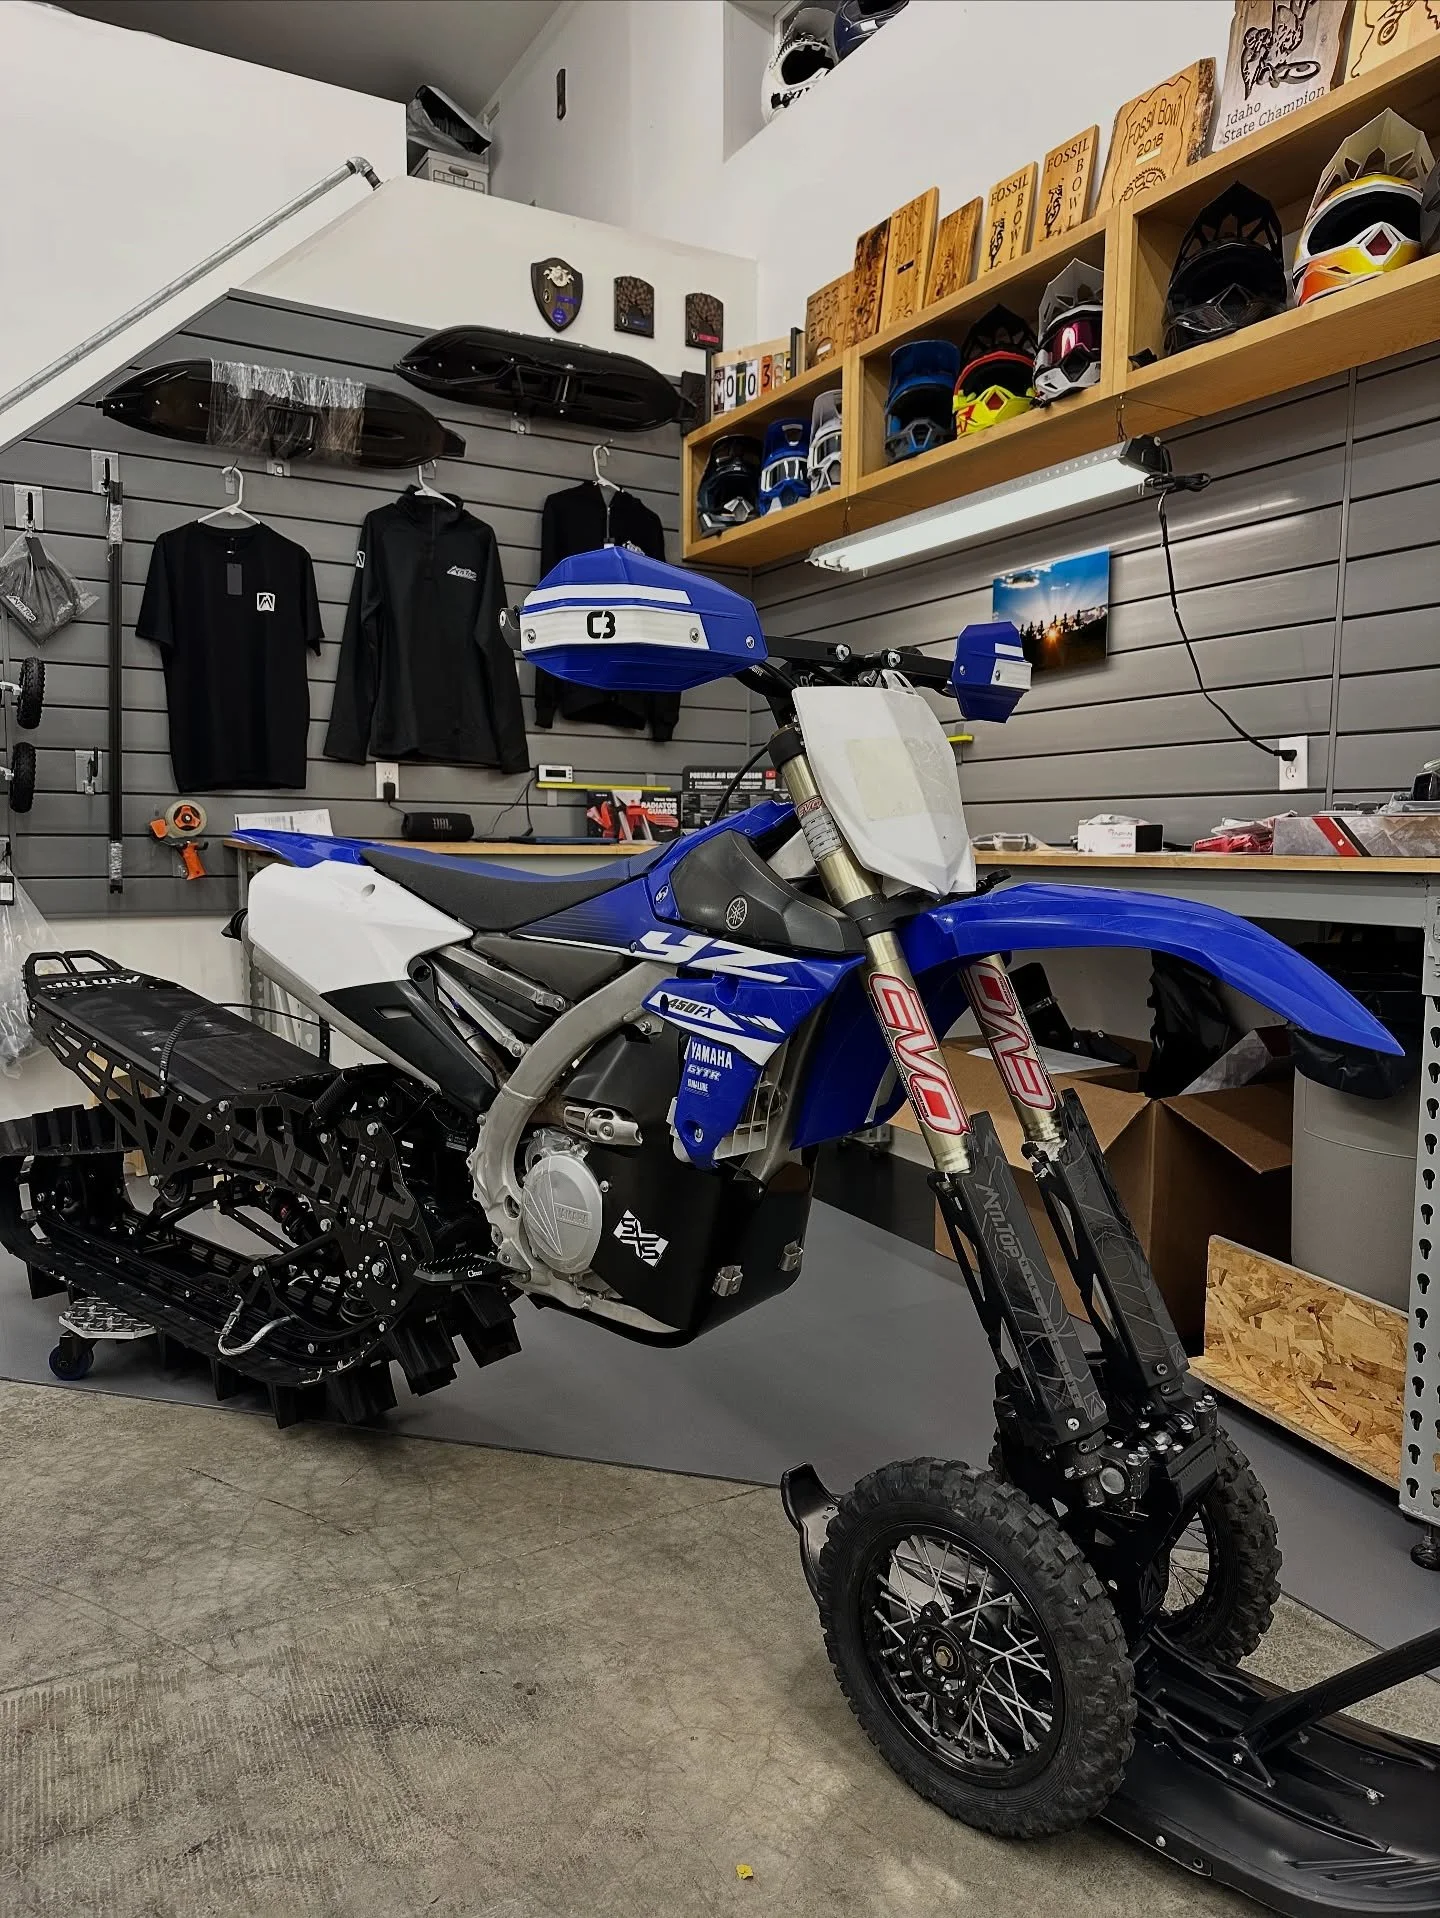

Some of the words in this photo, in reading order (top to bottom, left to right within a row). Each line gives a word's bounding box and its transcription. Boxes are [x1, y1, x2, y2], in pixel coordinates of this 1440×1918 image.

[1127, 100, 1157, 149] Fossil
[1157, 93, 1183, 128] Bowl
[1222, 120, 1256, 145] State
[1258, 86, 1325, 128] Champion
[1226, 101, 1262, 128] Idaho
[1046, 137, 1090, 173] FOSSIL
[1136, 132, 1165, 158] 2018
[990, 172, 1029, 217] FOSSIL
[1065, 157, 1084, 232] BOWL
[1009, 192, 1025, 260] BOWL
[714, 371, 756, 405] MOTO
[634, 930, 806, 984] YZ
[667, 998, 718, 1020] 450FX
[869, 973, 971, 1134] EVO
[969, 961, 1055, 1110] EVO
[687, 1063, 721, 1081] GYTR
[690, 1042, 733, 1070] YAMAHA
[1042, 1316, 1058, 1346] THE
